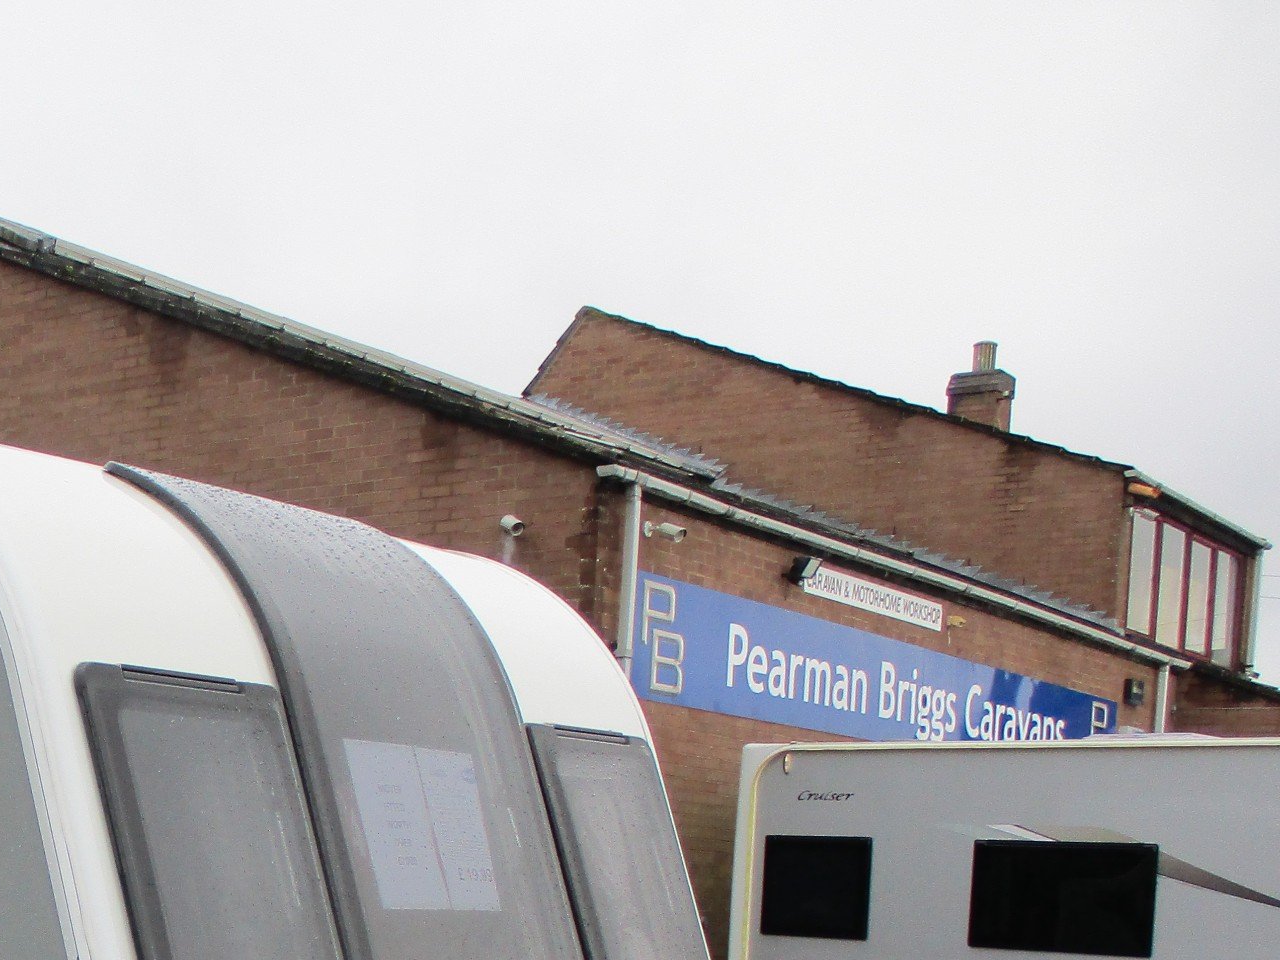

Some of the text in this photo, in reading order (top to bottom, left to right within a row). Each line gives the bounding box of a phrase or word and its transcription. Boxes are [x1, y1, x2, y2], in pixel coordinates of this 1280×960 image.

[843, 581, 850, 598] &
[852, 584, 902, 614] MOTORHOME
[903, 598, 941, 625] WORKSHOP
[726, 623, 1066, 741] Pearman Briggs Caravans
[797, 789, 855, 802] Cruiser
